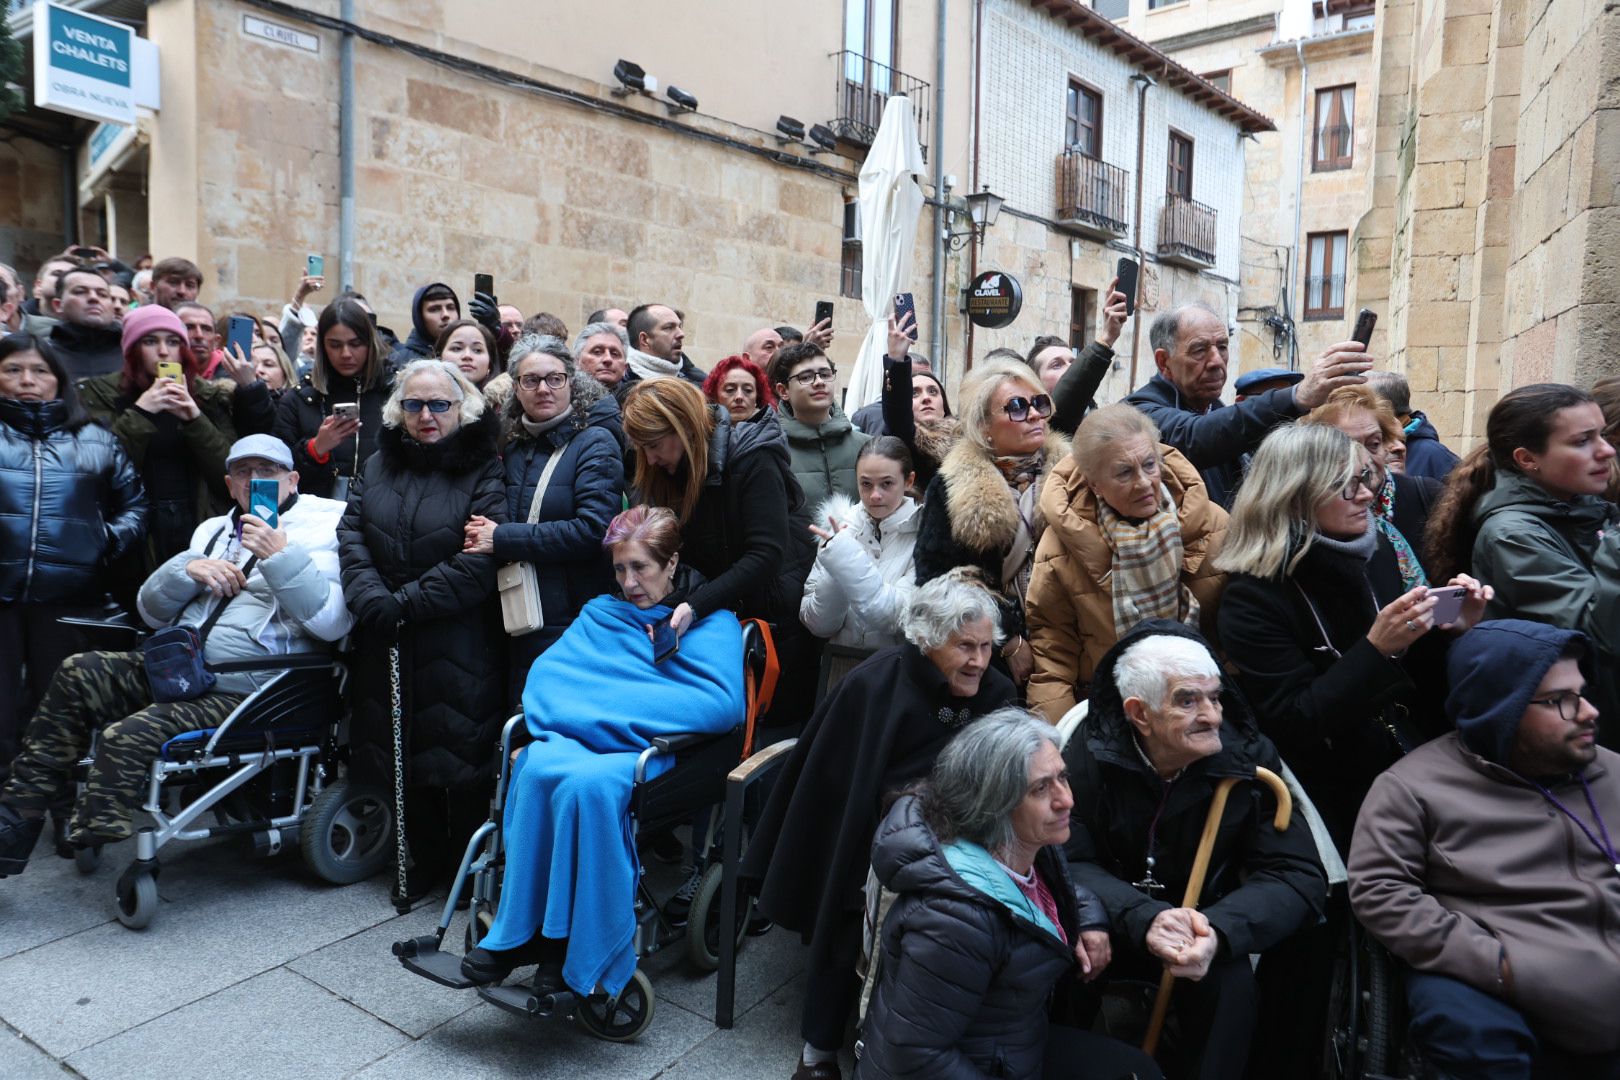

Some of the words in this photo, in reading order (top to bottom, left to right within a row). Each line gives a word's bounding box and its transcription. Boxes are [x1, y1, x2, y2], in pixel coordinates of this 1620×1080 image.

[63, 25, 118, 53] VENTA
[52, 40, 128, 72] CHALETS
[52, 82, 87, 97] OBRA
[90, 92, 128, 108] NUEVA
